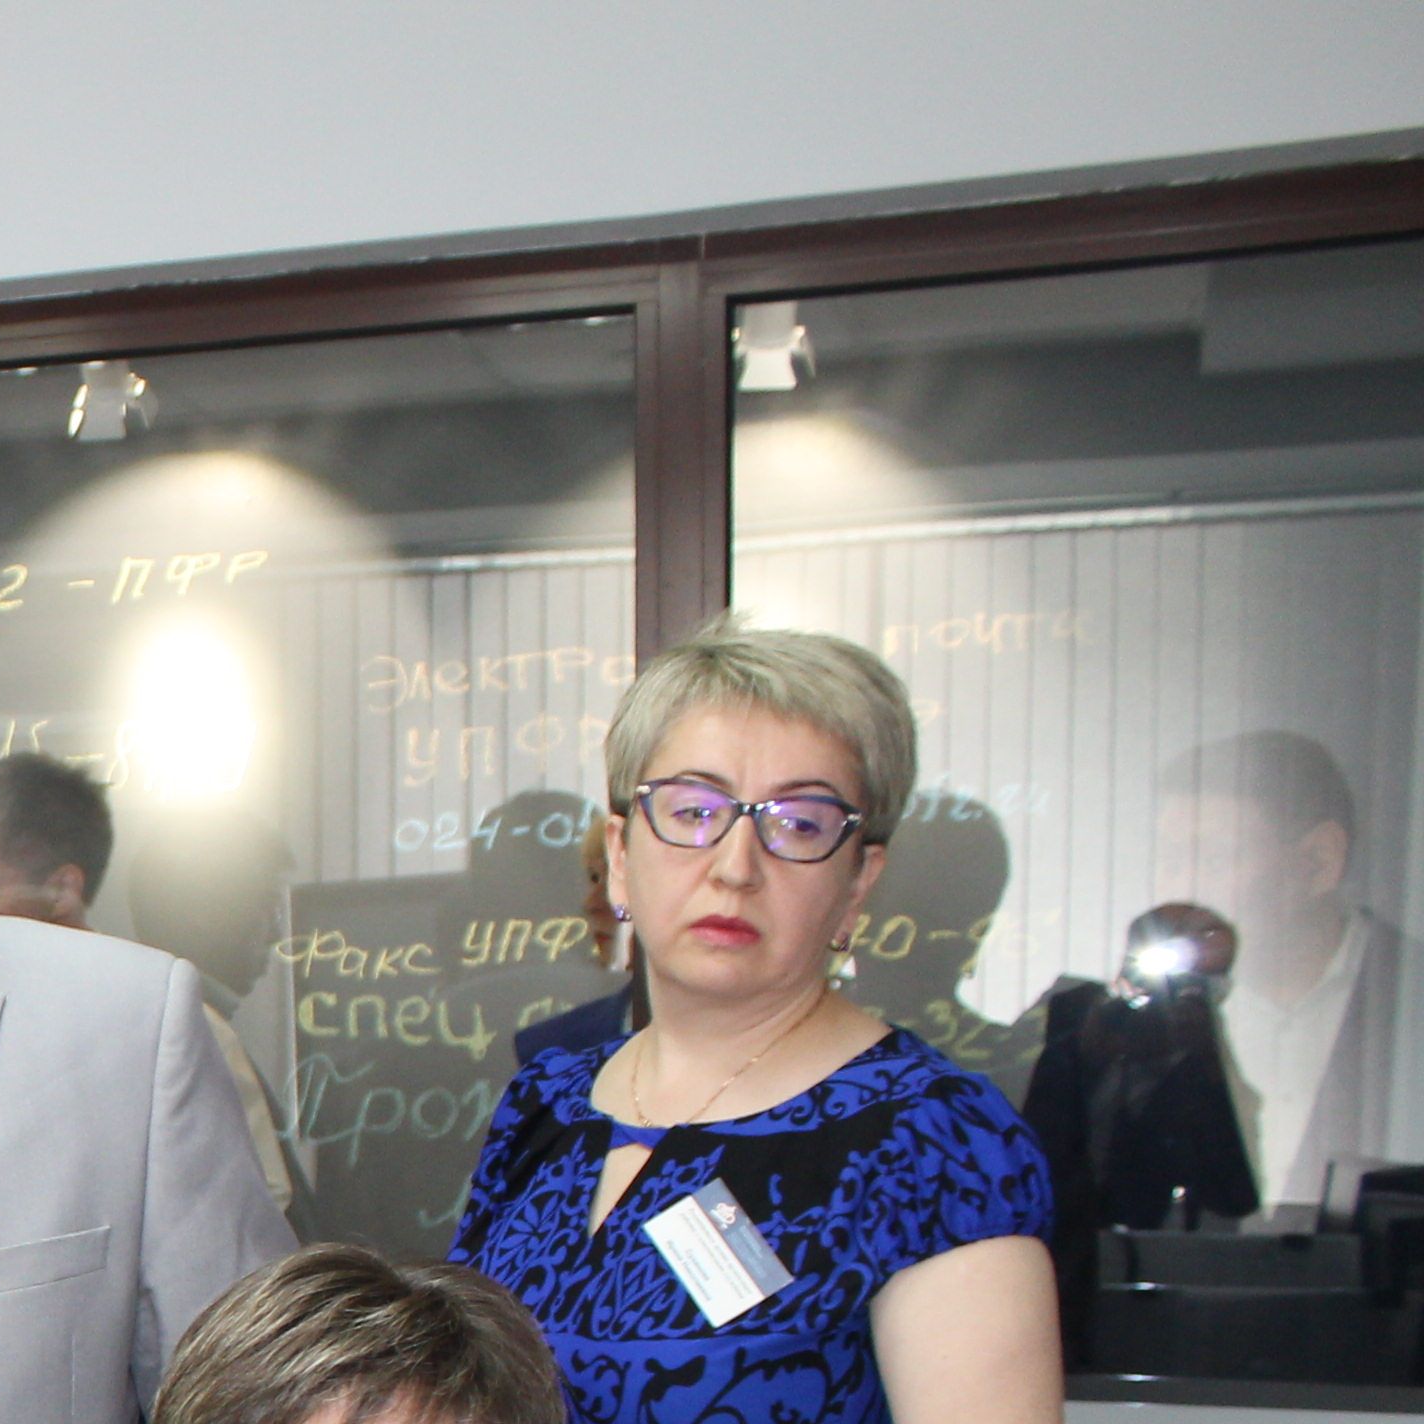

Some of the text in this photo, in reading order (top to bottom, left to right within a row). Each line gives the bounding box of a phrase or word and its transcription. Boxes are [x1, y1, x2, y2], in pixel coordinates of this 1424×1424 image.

[113, 551, 268, 604] ПФР
[360, 645, 636, 713] Электро
[461, 917, 601, 965] УПФ
